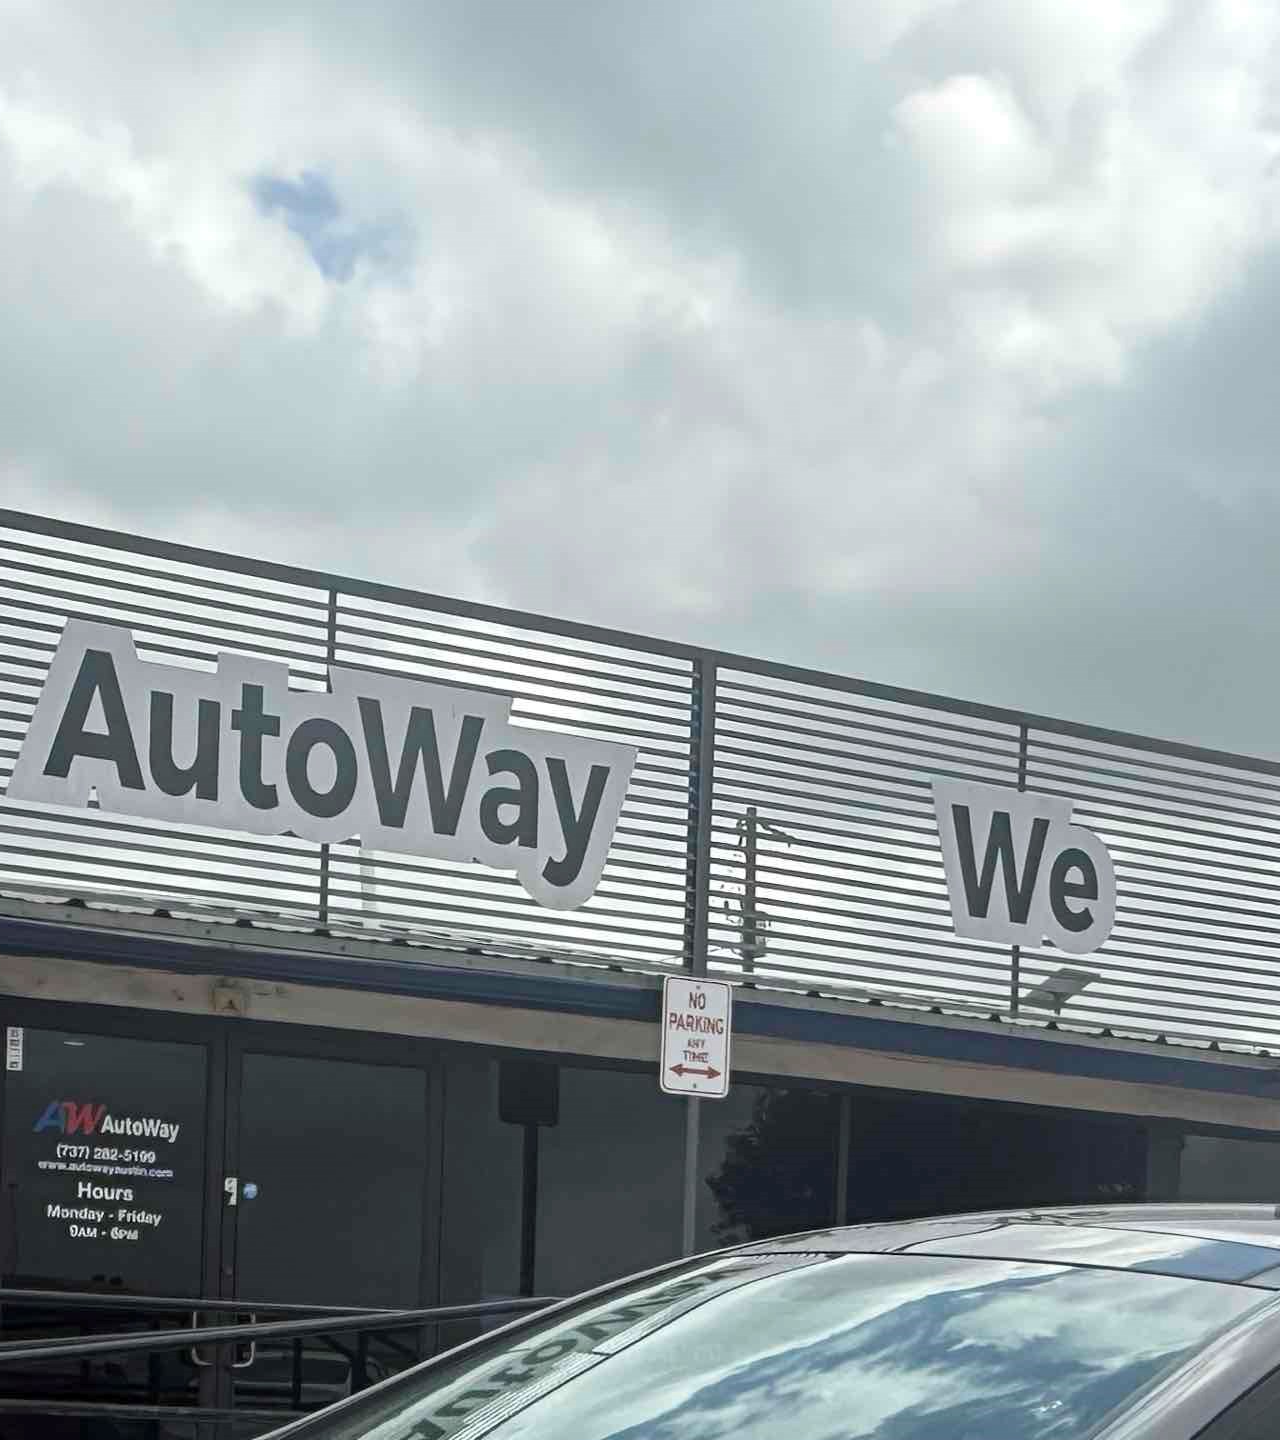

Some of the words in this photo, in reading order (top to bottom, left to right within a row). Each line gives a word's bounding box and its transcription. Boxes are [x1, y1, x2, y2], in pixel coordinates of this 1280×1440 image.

[42, 648, 611, 887] AutoWay
[951, 804, 1099, 933] We
[688, 991, 707, 1011] NO
[668, 1012, 725, 1035] PARKING
[682, 1050, 710, 1063] TIME
[100, 1114, 180, 1144] AutoWay
[56, 1143, 90, 1159] (737)
[77, 1181, 134, 1201] Hours
[46, 1204, 105, 1222] Monday
[117, 1209, 162, 1227] Friday
